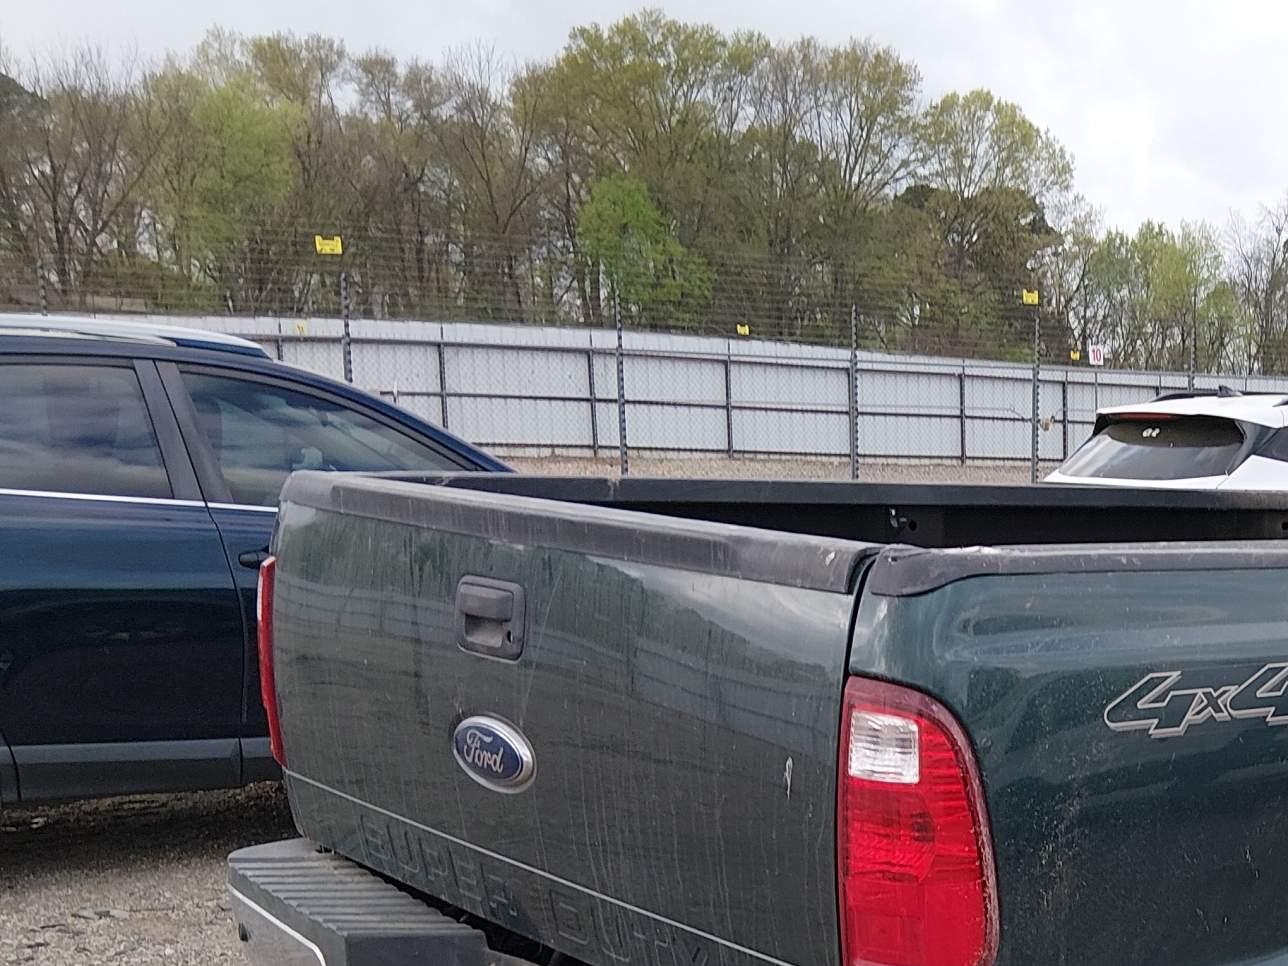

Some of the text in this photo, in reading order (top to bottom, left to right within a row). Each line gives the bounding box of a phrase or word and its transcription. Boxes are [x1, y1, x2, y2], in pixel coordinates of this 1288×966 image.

[1092, 348, 1102, 361] 10
[464, 729, 504, 773] Ford
[359, 814, 520, 922] SUPER
